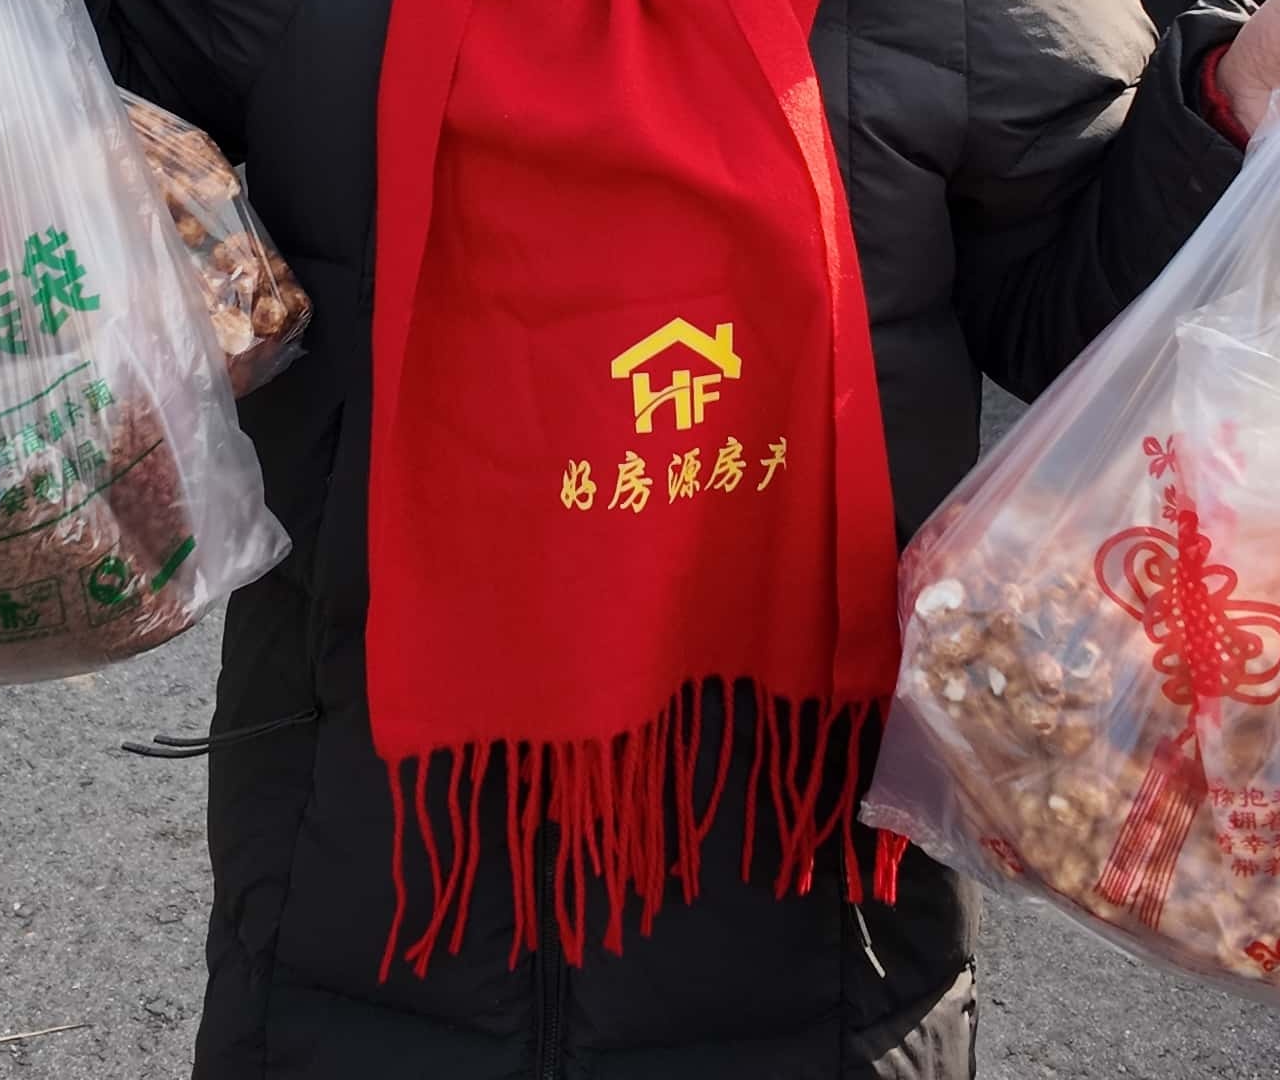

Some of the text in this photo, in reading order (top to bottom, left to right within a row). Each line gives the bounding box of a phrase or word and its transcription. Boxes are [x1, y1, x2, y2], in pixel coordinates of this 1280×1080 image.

[633, 369, 721, 433] HF
[560, 436, 787, 513] 好房源房产
